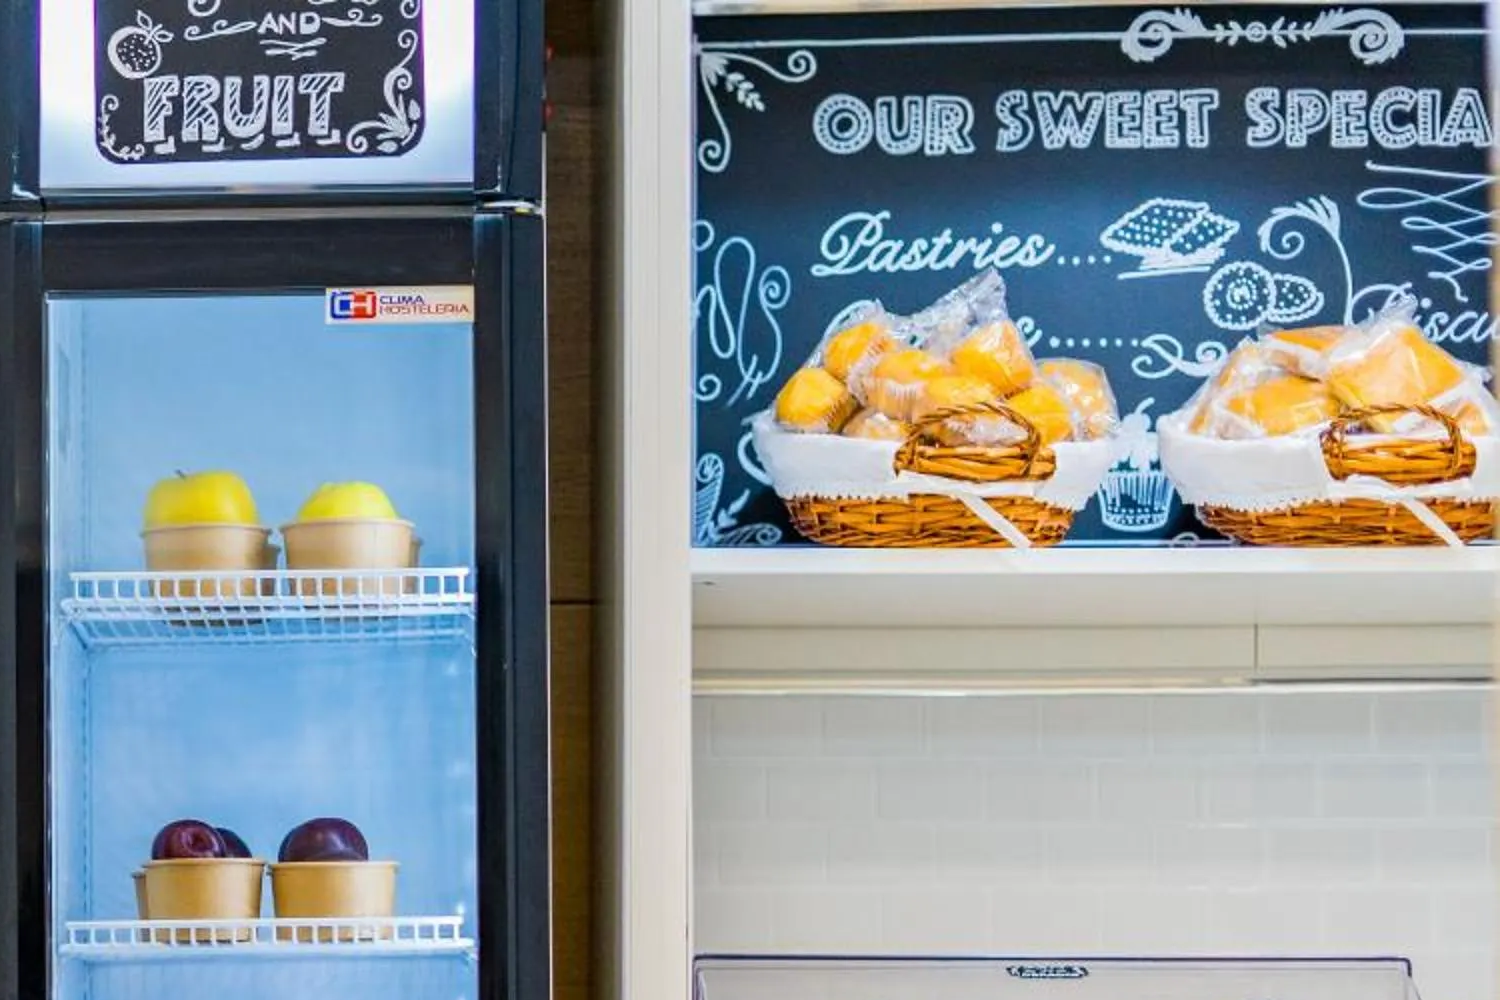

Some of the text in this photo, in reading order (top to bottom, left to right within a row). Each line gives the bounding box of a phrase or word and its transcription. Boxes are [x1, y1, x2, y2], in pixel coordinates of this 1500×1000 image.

[258, 11, 321, 36] AND
[143, 71, 346, 155] FRUIT
[812, 93, 976, 156] OUR
[995, 88, 1220, 152] SWEET
[379, 295, 426, 305] CLIMA
[379, 303, 470, 315] HOSTELERIA
